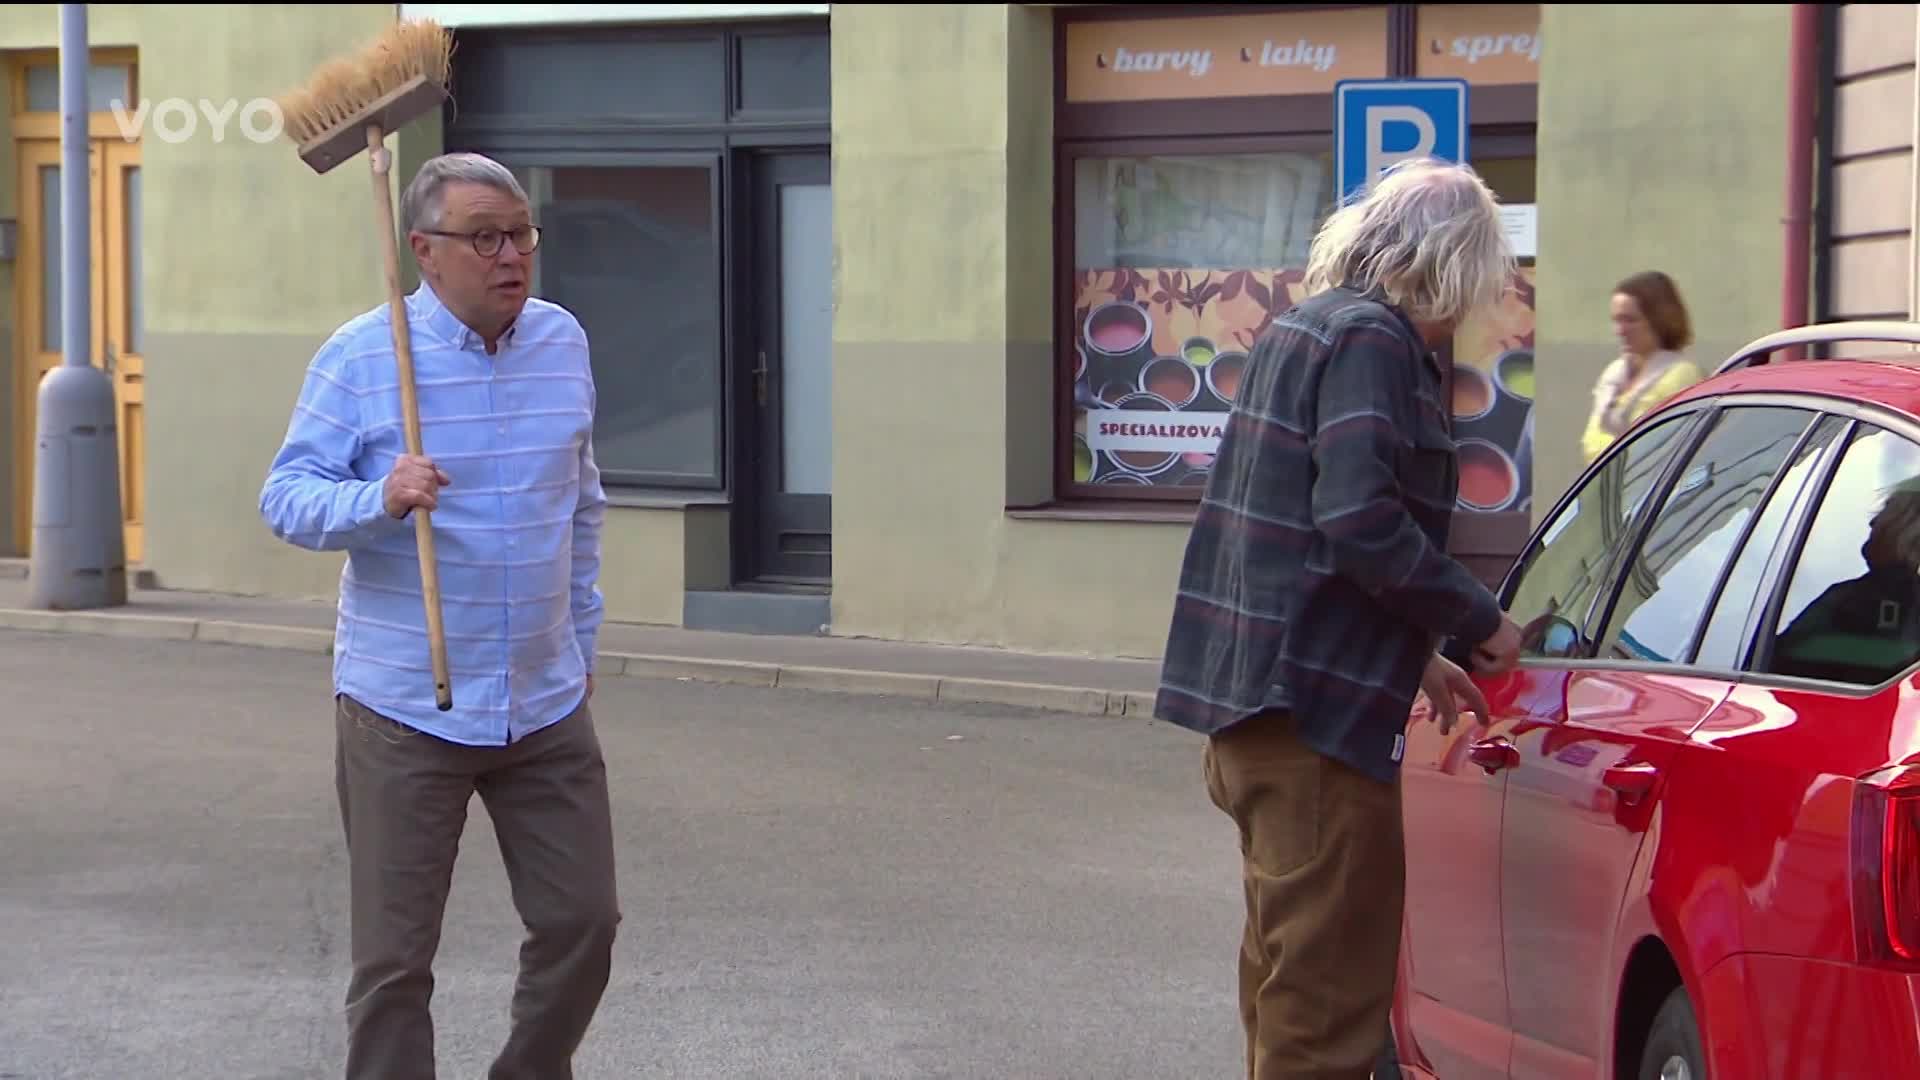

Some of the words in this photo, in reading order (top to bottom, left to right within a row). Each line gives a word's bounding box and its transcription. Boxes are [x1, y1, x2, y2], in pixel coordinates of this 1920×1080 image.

[1113, 47, 1213, 76] barvy
[1259, 39, 1337, 72] laky
[1365, 104, 1437, 189] P
[1099, 422, 1223, 438] SPECIALIZOVA
